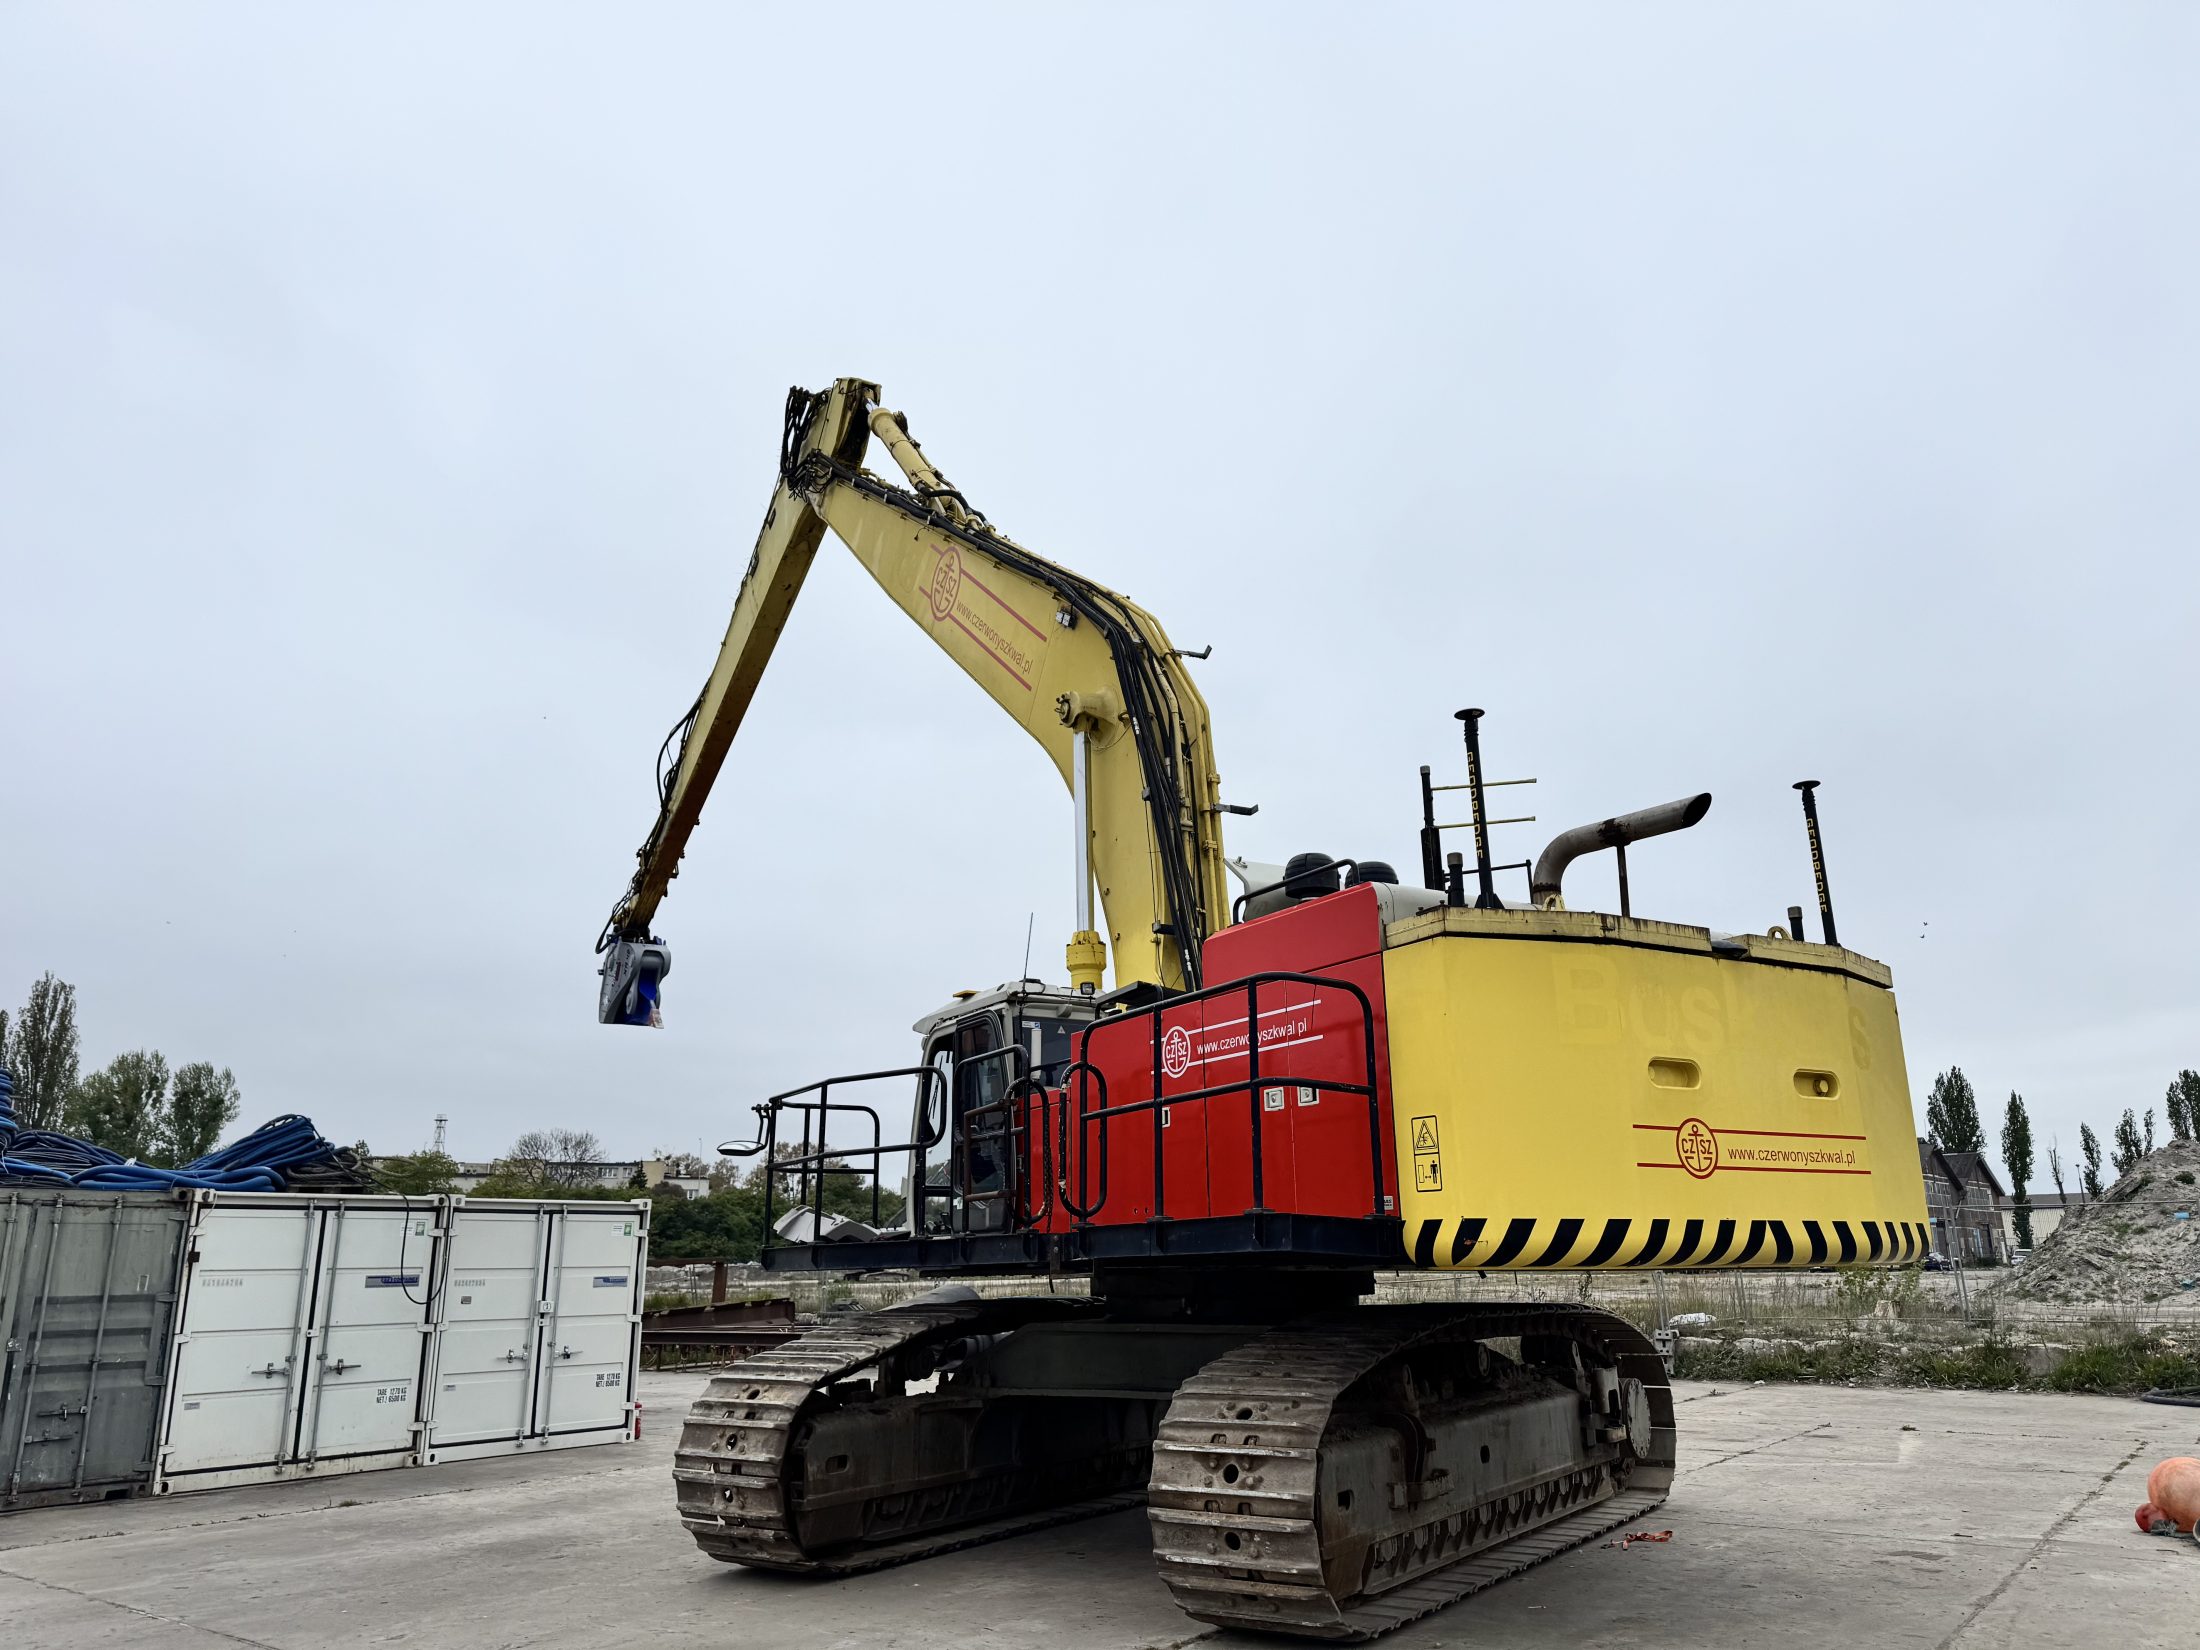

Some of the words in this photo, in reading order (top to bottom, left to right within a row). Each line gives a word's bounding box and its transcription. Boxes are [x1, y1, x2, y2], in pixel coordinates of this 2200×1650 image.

[956, 599, 1034, 675] www.czerwonyszkwal.pl
[1727, 1147, 1856, 1168] www.czerwonyszkwal.pl
[401, 1386, 407, 1394] KG
[400, 1394, 406, 1402] KG
